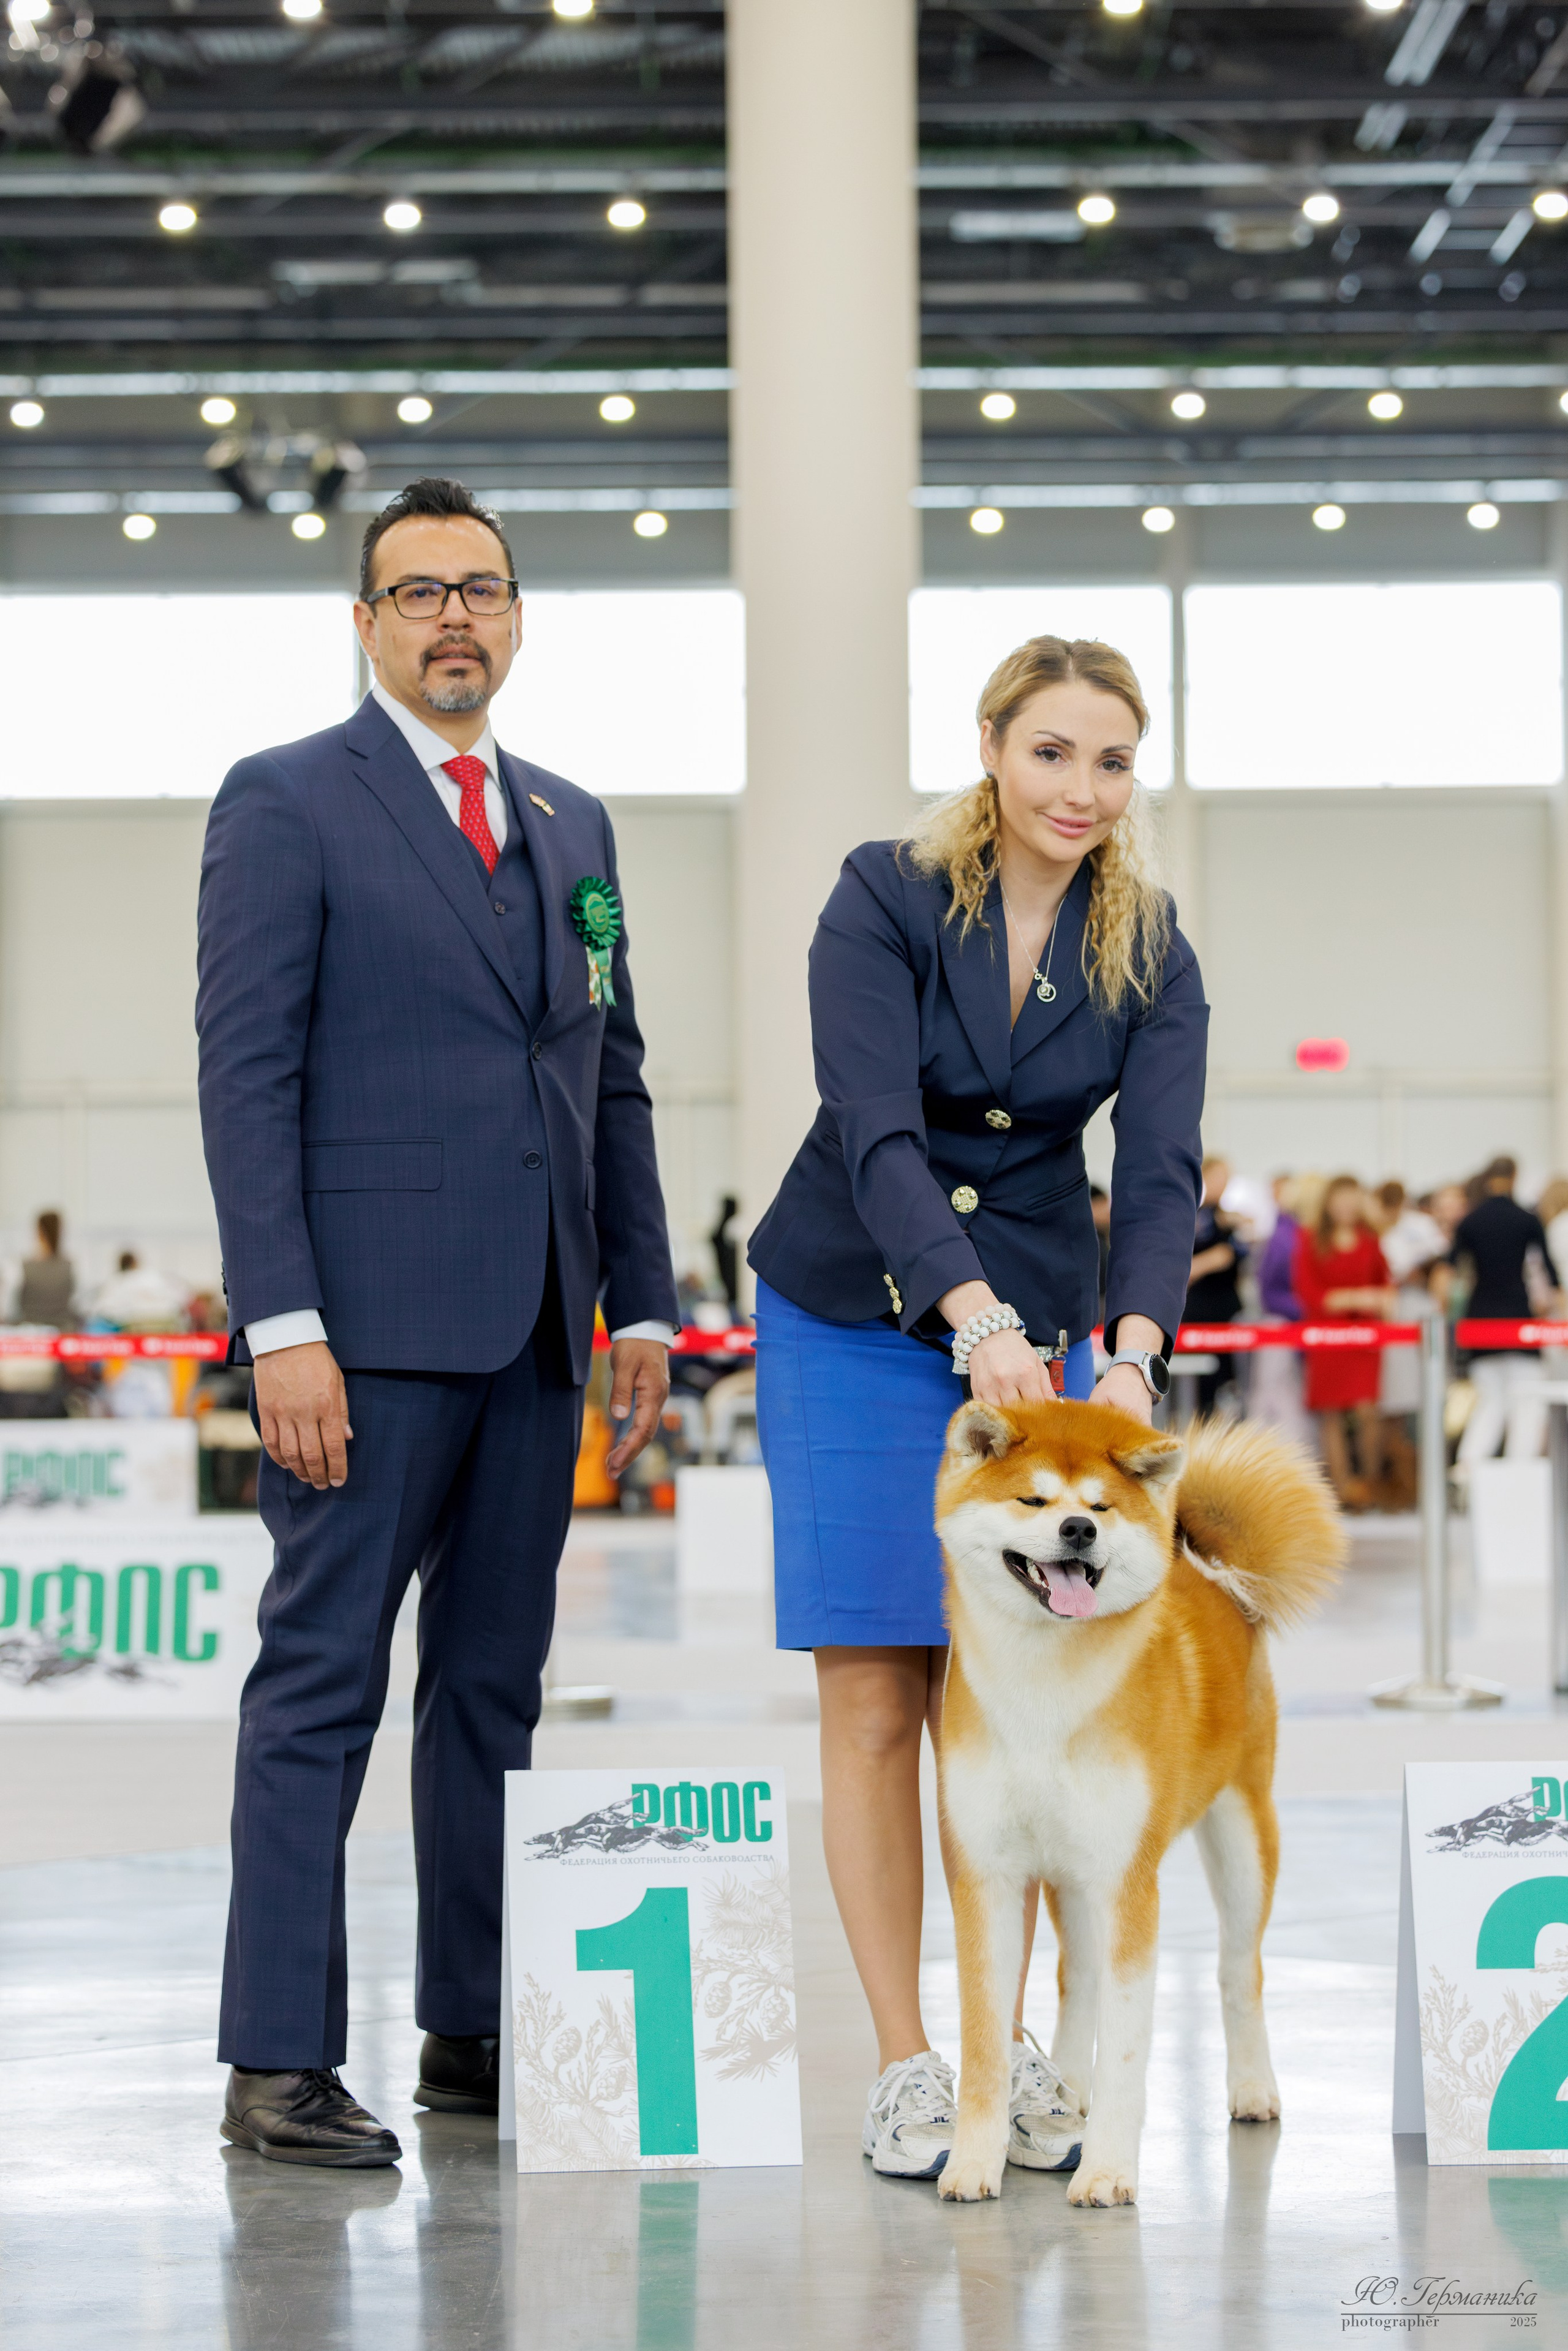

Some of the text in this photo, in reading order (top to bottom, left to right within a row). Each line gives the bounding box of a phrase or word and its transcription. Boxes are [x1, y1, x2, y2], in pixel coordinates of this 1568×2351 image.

[631, 1781, 773, 1843] РФОС
[559, 1854, 774, 1866] ФЕДЕРАЦИЯ ОХОТНИЧЬЕГО СОБАКОВОДСТВА
[1462, 1850, 1520, 1859] ФЕДЕРАЦИЯ
[576, 1887, 699, 2156] 1
[1476, 1875, 1568, 2151] 2
